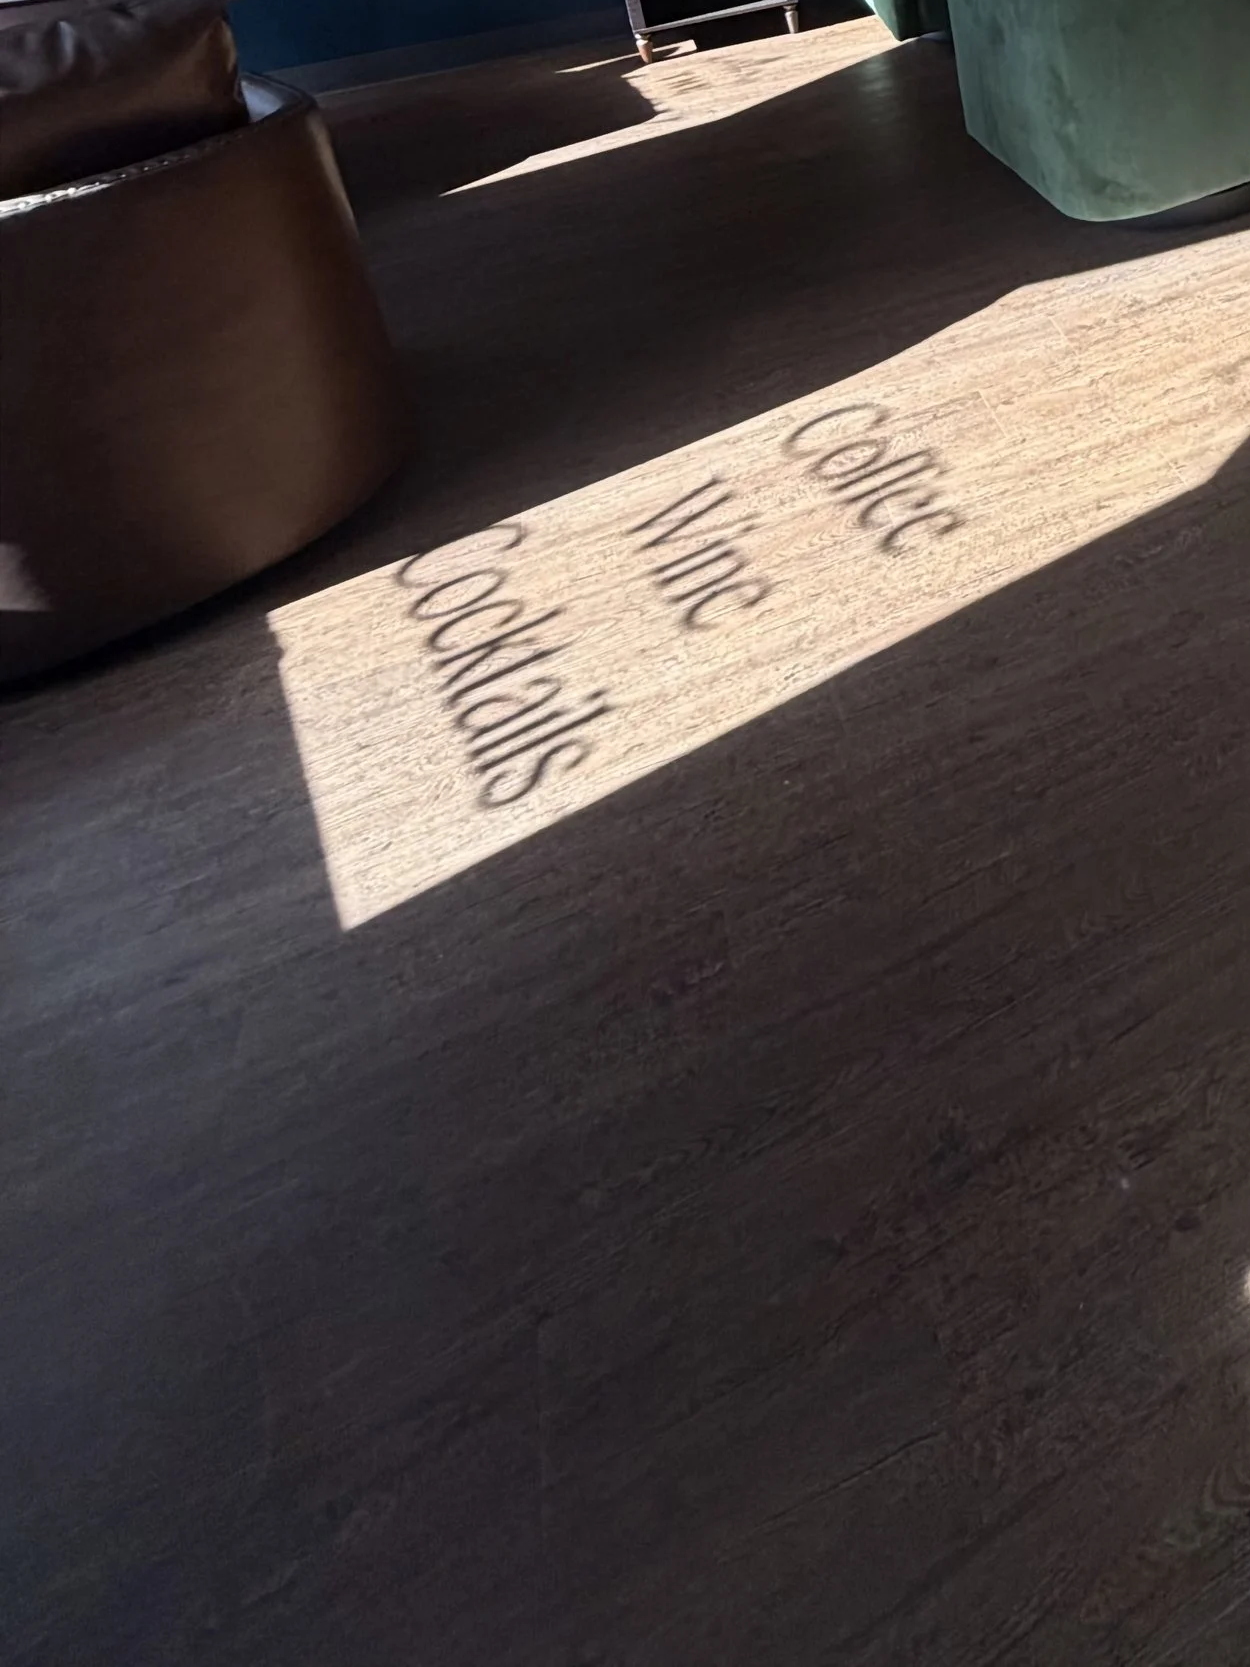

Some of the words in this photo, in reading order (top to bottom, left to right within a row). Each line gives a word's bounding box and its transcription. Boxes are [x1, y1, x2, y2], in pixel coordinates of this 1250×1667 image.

[629, 477, 770, 628] Wine
[783, 402, 962, 556] Coffee
[396, 523, 612, 807] Cocktails
